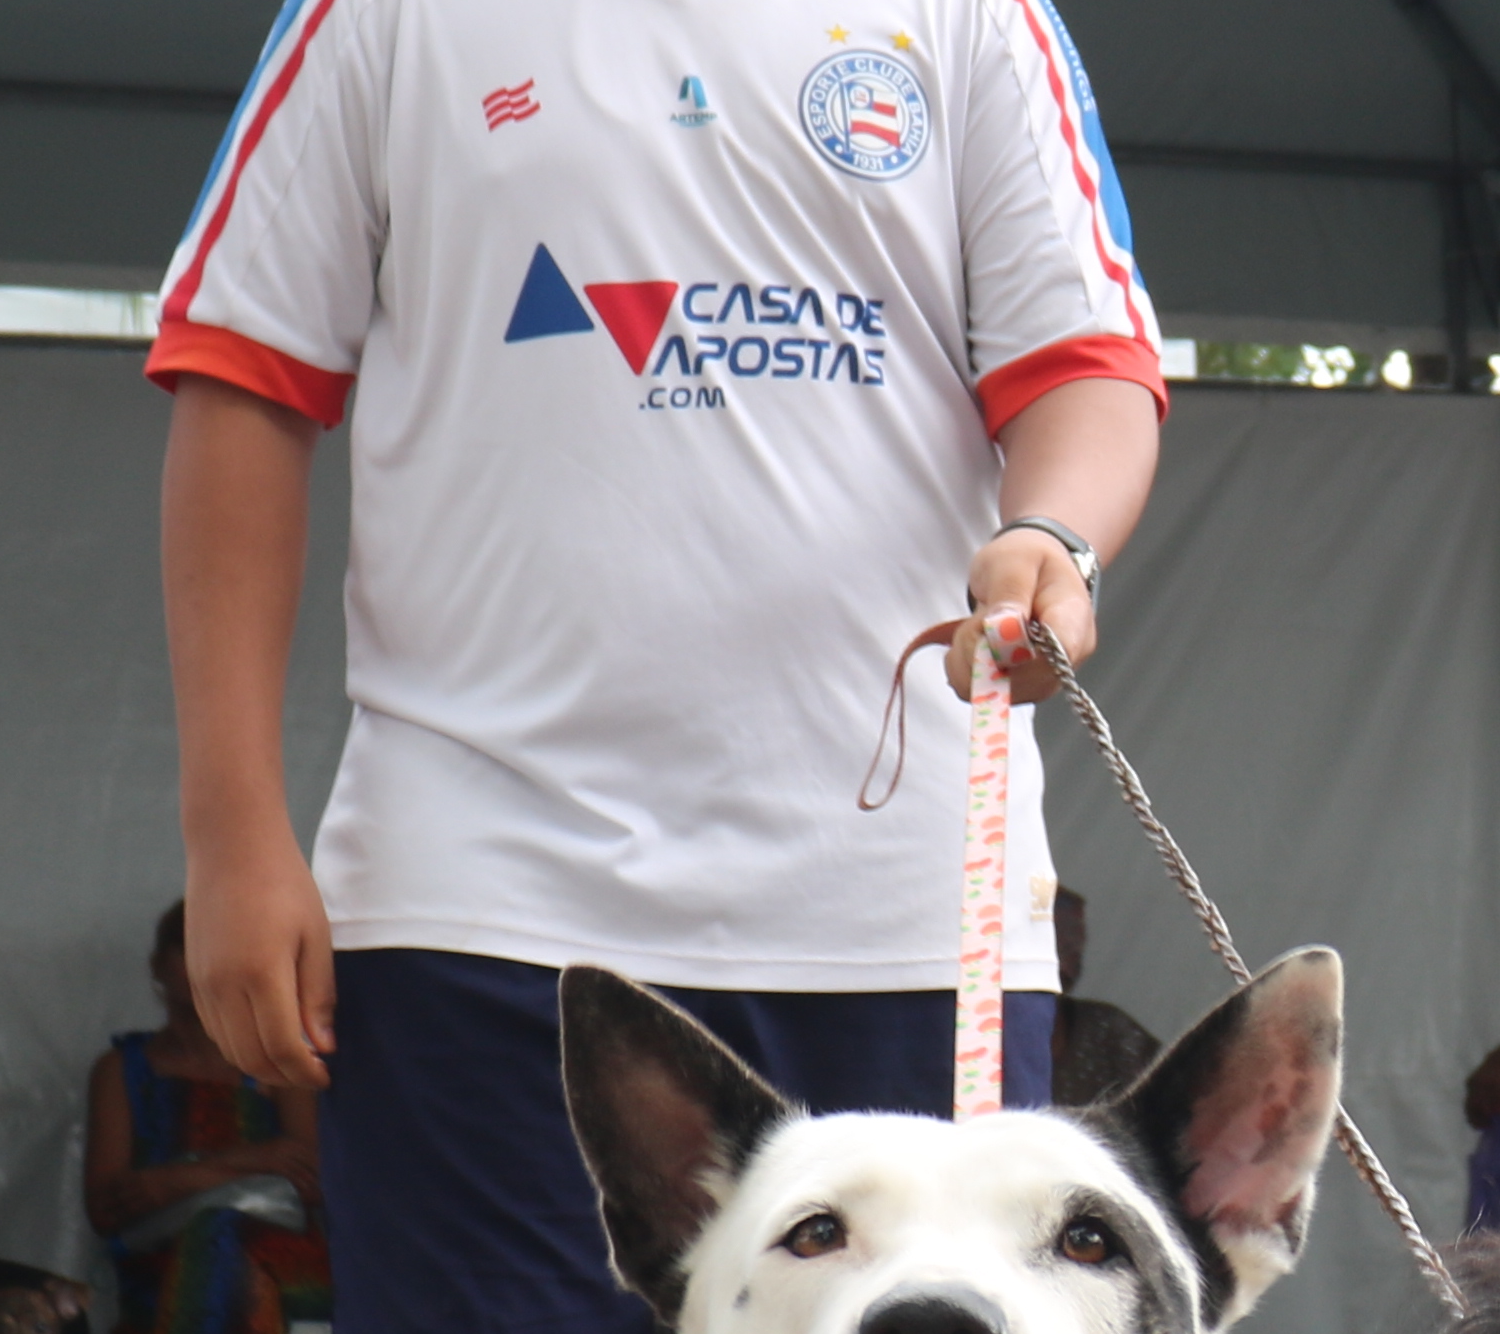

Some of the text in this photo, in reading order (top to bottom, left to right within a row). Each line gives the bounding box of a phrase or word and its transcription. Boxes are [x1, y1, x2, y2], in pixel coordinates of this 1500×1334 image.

[810, 58, 923, 156] ESPORTE CLUBE BAHIA
[852, 152, 885, 171] 1931
[682, 282, 886, 338] CASA DE
[651, 334, 886, 386] APOSTAS
[638, 385, 727, 410] .COM
